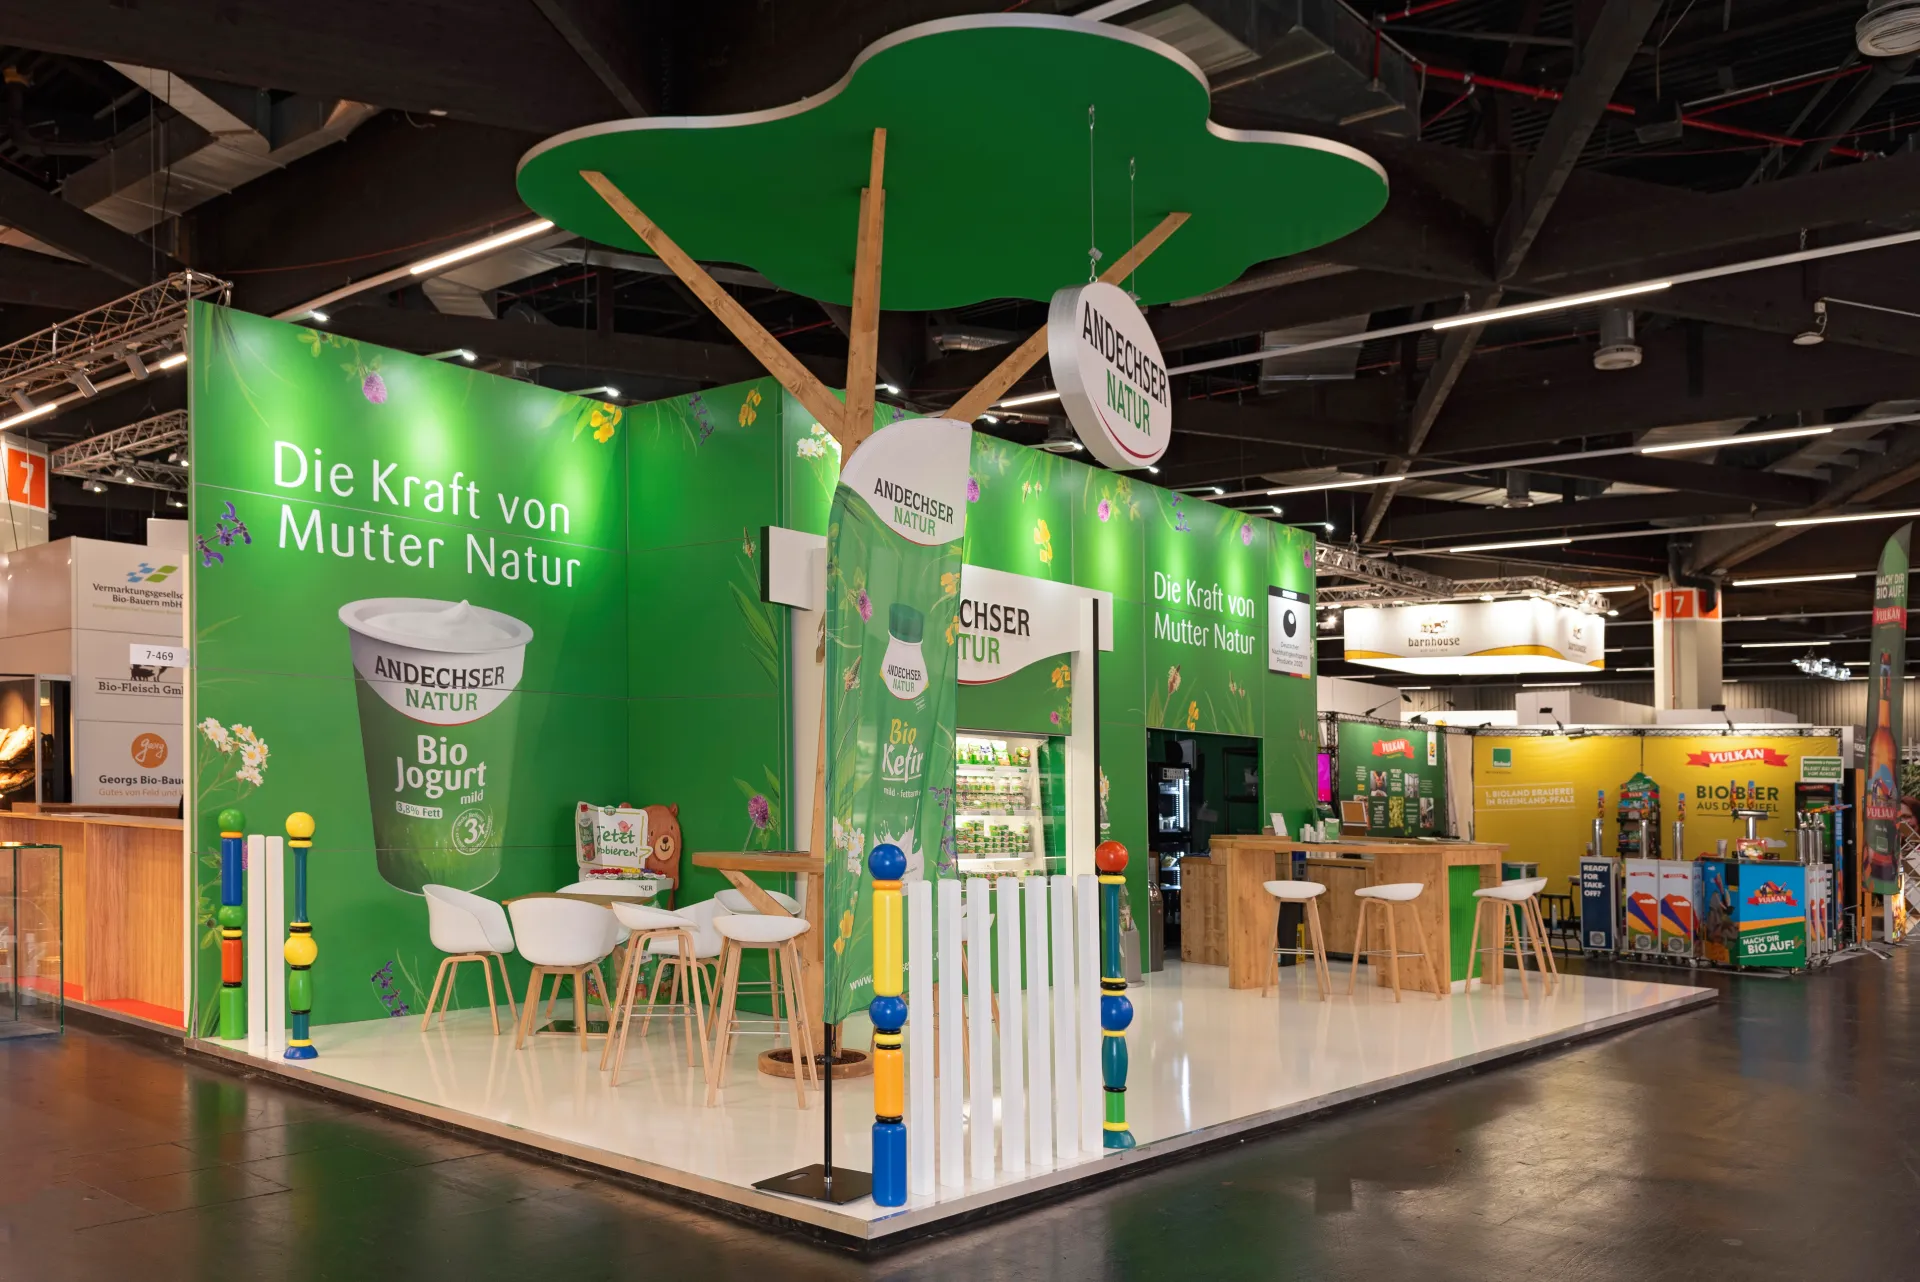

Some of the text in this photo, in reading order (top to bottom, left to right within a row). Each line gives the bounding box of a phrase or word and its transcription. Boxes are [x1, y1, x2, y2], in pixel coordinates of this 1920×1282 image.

[1082, 300, 1168, 408] ANDECHSER
[1106, 368, 1151, 437] NATUR
[20, 461, 35, 495] 7
[274, 440, 570, 535] Die Kraft von
[874, 477, 955, 525] ANDECHSER
[893, 505, 937, 537] NATUR
[278, 503, 581, 588] Mutter Natur
[93, 583, 183, 600] Vermarktungsgesellsc
[1154, 571, 1255, 619] Die Kraft von
[112, 594, 160, 606] Bio-Bauern
[161, 599, 183, 609] mbH
[1673, 596, 1685, 613] 7
[960, 599, 1030, 636] CHSER
[1876, 607, 1901, 621] VULKAN
[1154, 611, 1256, 655] Mutter Natur
[957, 633, 1000, 664] TUR
[1408, 637, 1460, 647] barnhouse
[146, 650, 174, 661] 7-469
[375, 655, 505, 689] ANDECHSER
[887, 664, 921, 681] ANDECHSER
[98, 681, 183, 695] Bio-Fleisch Gm
[893, 678, 915, 693] NATUR
[405, 688, 478, 712] NATUR
[889, 718, 917, 745] Bio
[417, 734, 468, 766] Bio
[1709, 748, 1764, 763] VULKAN
[882, 743, 924, 783] Kefir
[98, 775, 138, 786] Georgs
[394, 761, 487, 799] Jogurt
[460, 789, 484, 805] mild
[883, 787, 896, 797] mild
[1493, 789, 1530, 798] BIOLAND
[1532, 787, 1574, 796] BRAUEREI
[1696, 785, 1779, 801] BIO BER
[397, 803, 441, 818] 3,8% Fett
[1696, 802, 1719, 811] AUS
[1722, 802, 1744, 812] DR
[1758, 895, 1787, 904] VULKAN
[1747, 939, 1795, 954] BIO AUF!
